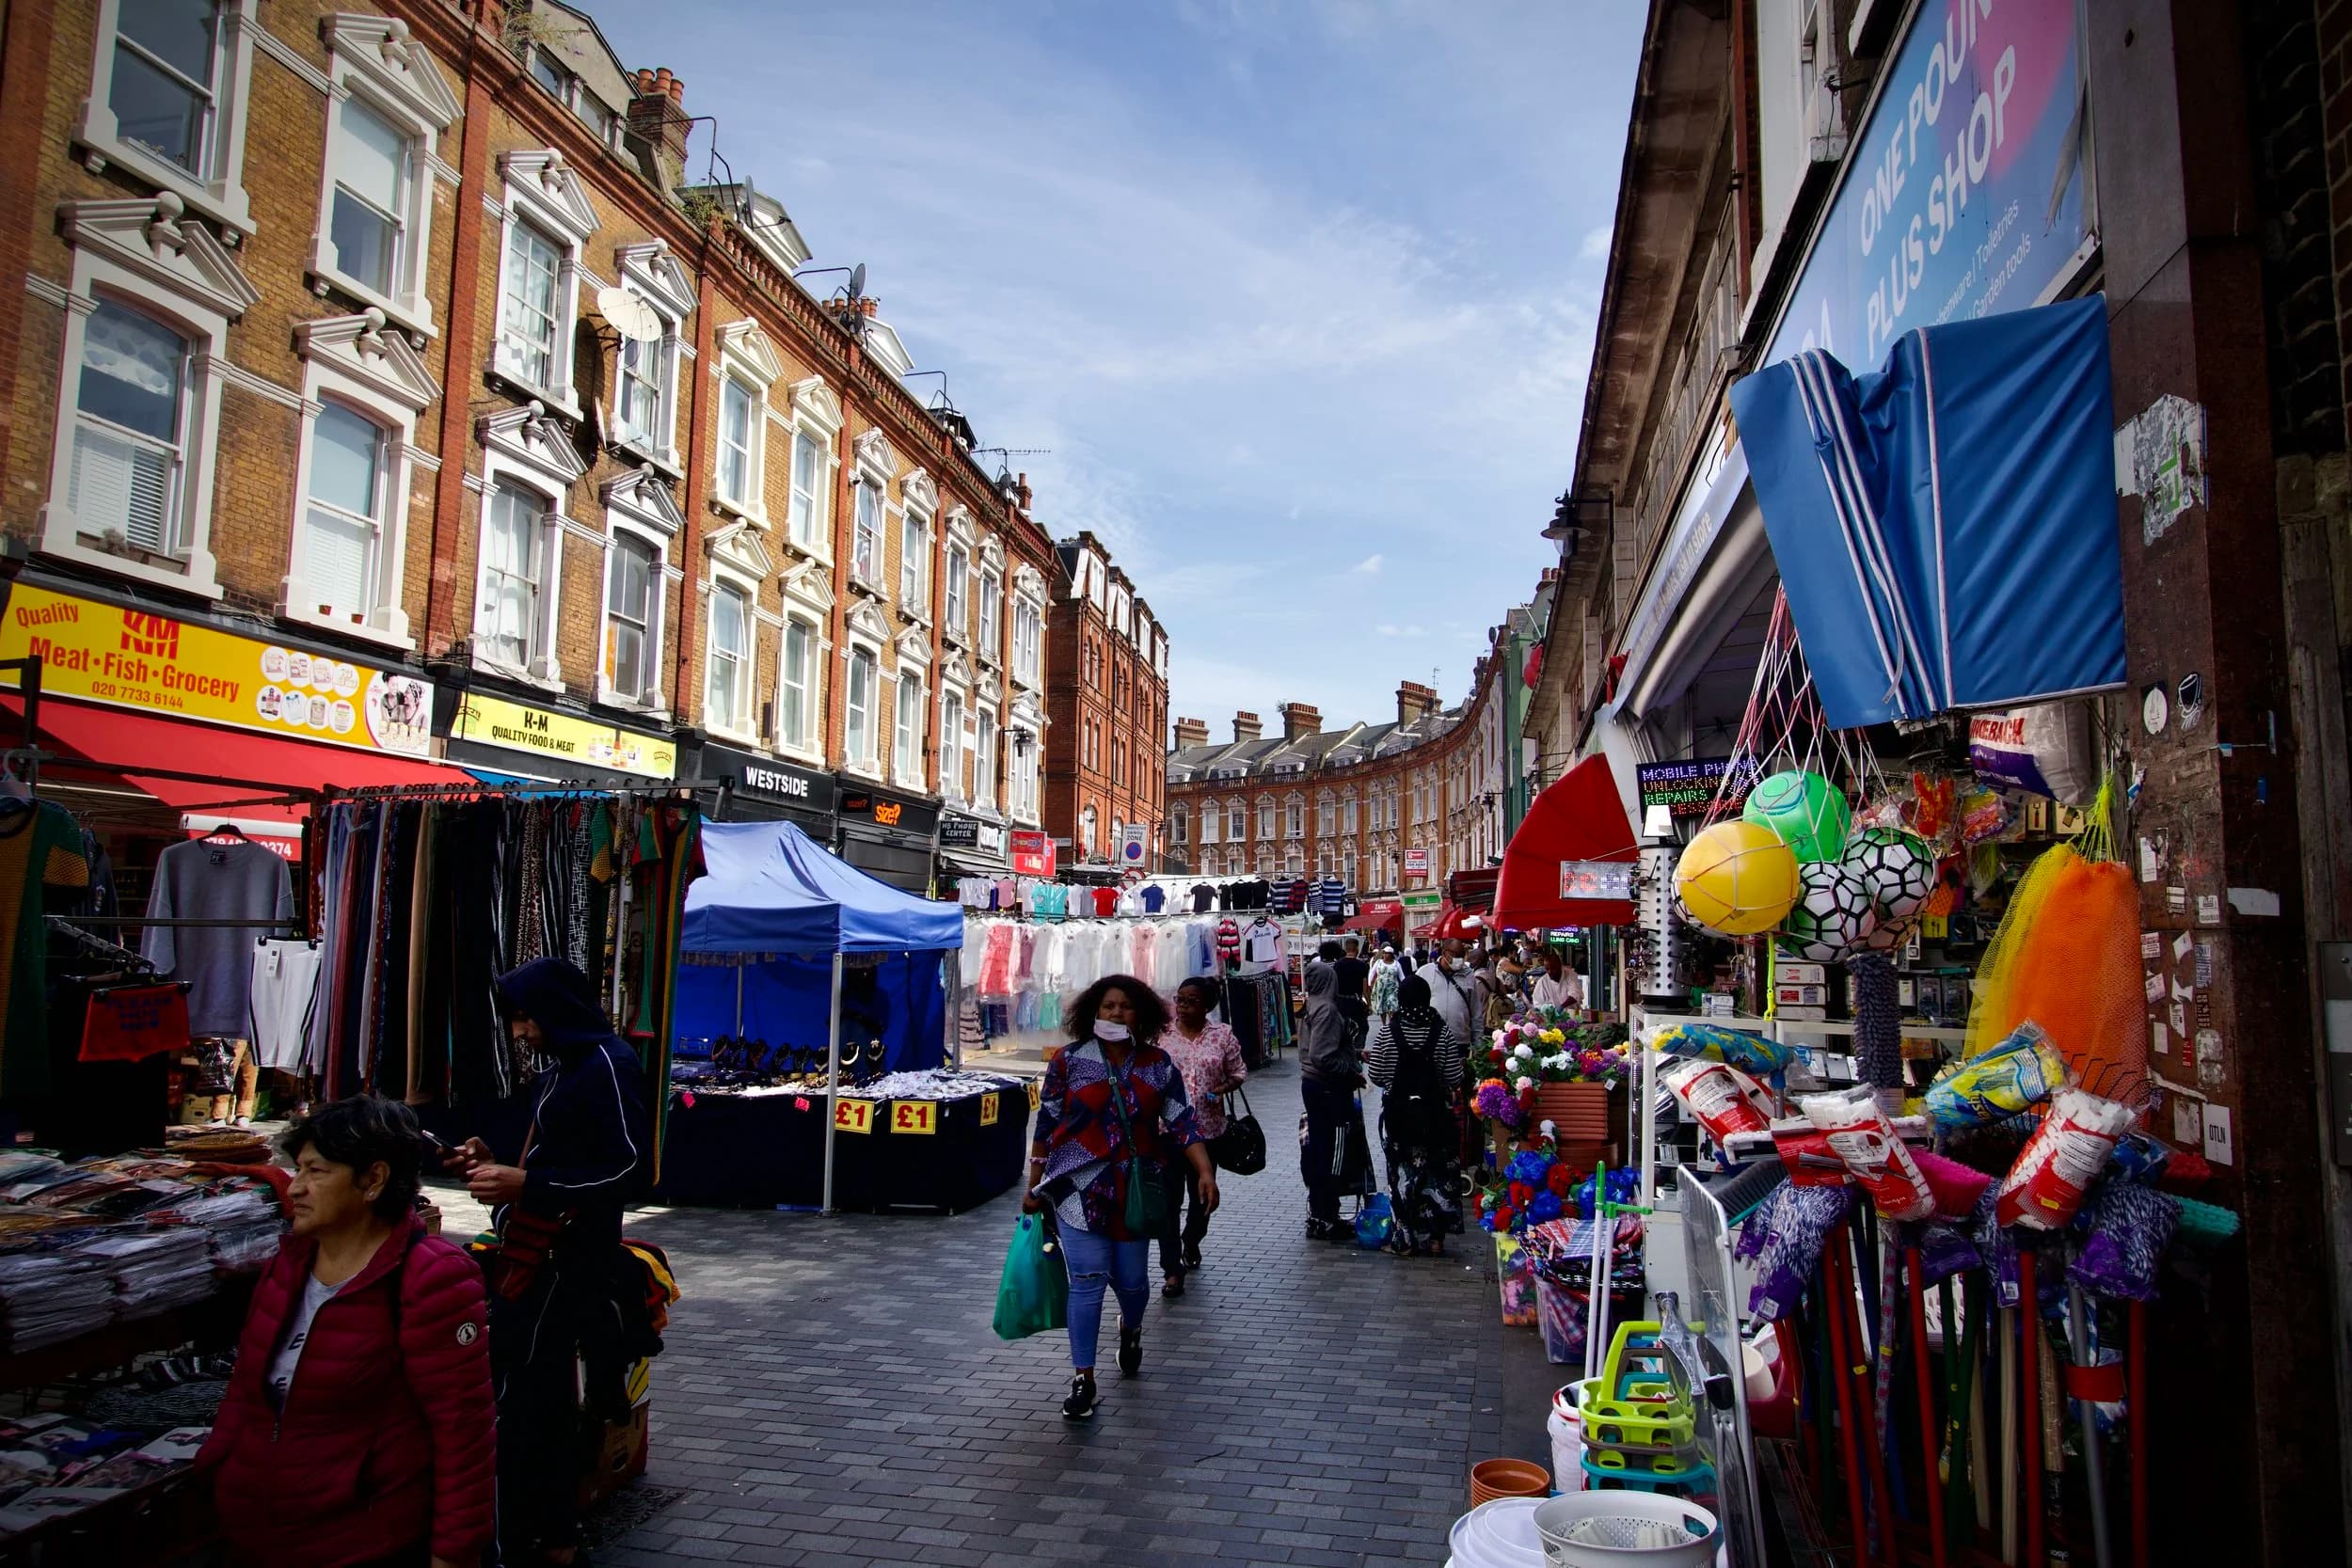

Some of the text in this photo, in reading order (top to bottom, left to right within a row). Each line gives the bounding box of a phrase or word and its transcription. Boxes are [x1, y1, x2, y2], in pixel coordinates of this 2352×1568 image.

[1861, 119, 1905, 256] ONE
[1867, 45, 2015, 363] PLUS SHOP
[1977, 198, 2018, 271] Toiletries
[2007, 232, 2031, 279] tools
[16, 602, 79, 627] Quality
[120, 610, 180, 659] KM
[30, 636, 240, 703] Meat Fish Grocery
[92, 681, 183, 708] 020 7733 6144
[524, 710, 548, 733] K-M
[492, 725, 575, 753] QUALITY FOOD & MEAT
[745, 766, 808, 798] WESTSIDE
[1642, 766, 1698, 781] MOBILE
[1645, 789, 1708, 805] REPAIRS
[875, 801, 901, 826] size?
[836, 1101, 866, 1127] £1
[897, 1104, 927, 1128] £1
[983, 1097, 995, 1119] £1
